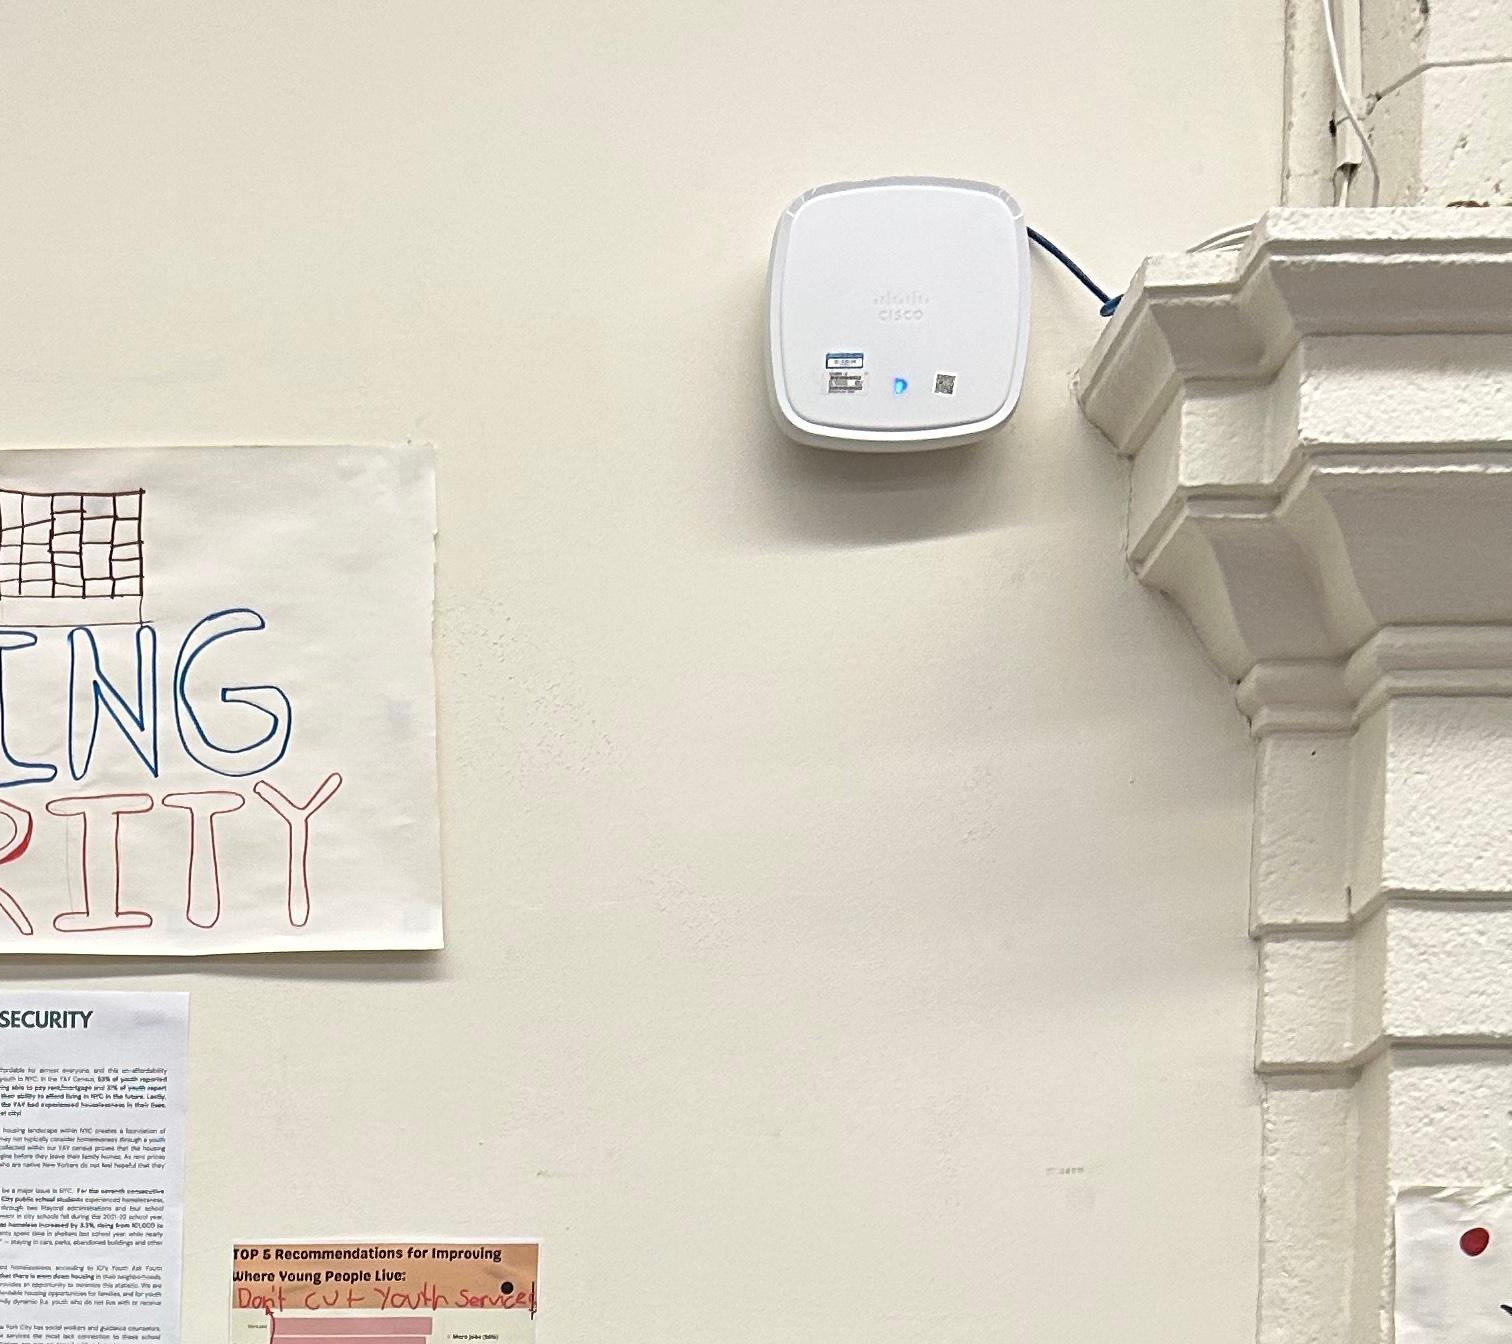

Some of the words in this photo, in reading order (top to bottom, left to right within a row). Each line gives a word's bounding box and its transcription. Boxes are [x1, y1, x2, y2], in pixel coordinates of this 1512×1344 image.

[233, 1248, 259, 1261] TOP
[275, 1247, 402, 1260] Recommendations
[407, 1247, 428, 1260] for
[432, 1247, 502, 1263] Improving
[232, 1270, 275, 1282] Where
[279, 1270, 321, 1284] Young
[325, 1270, 372, 1284] People
[375, 1270, 406, 1282] Live:
[373, 1286, 448, 1311] Youth
